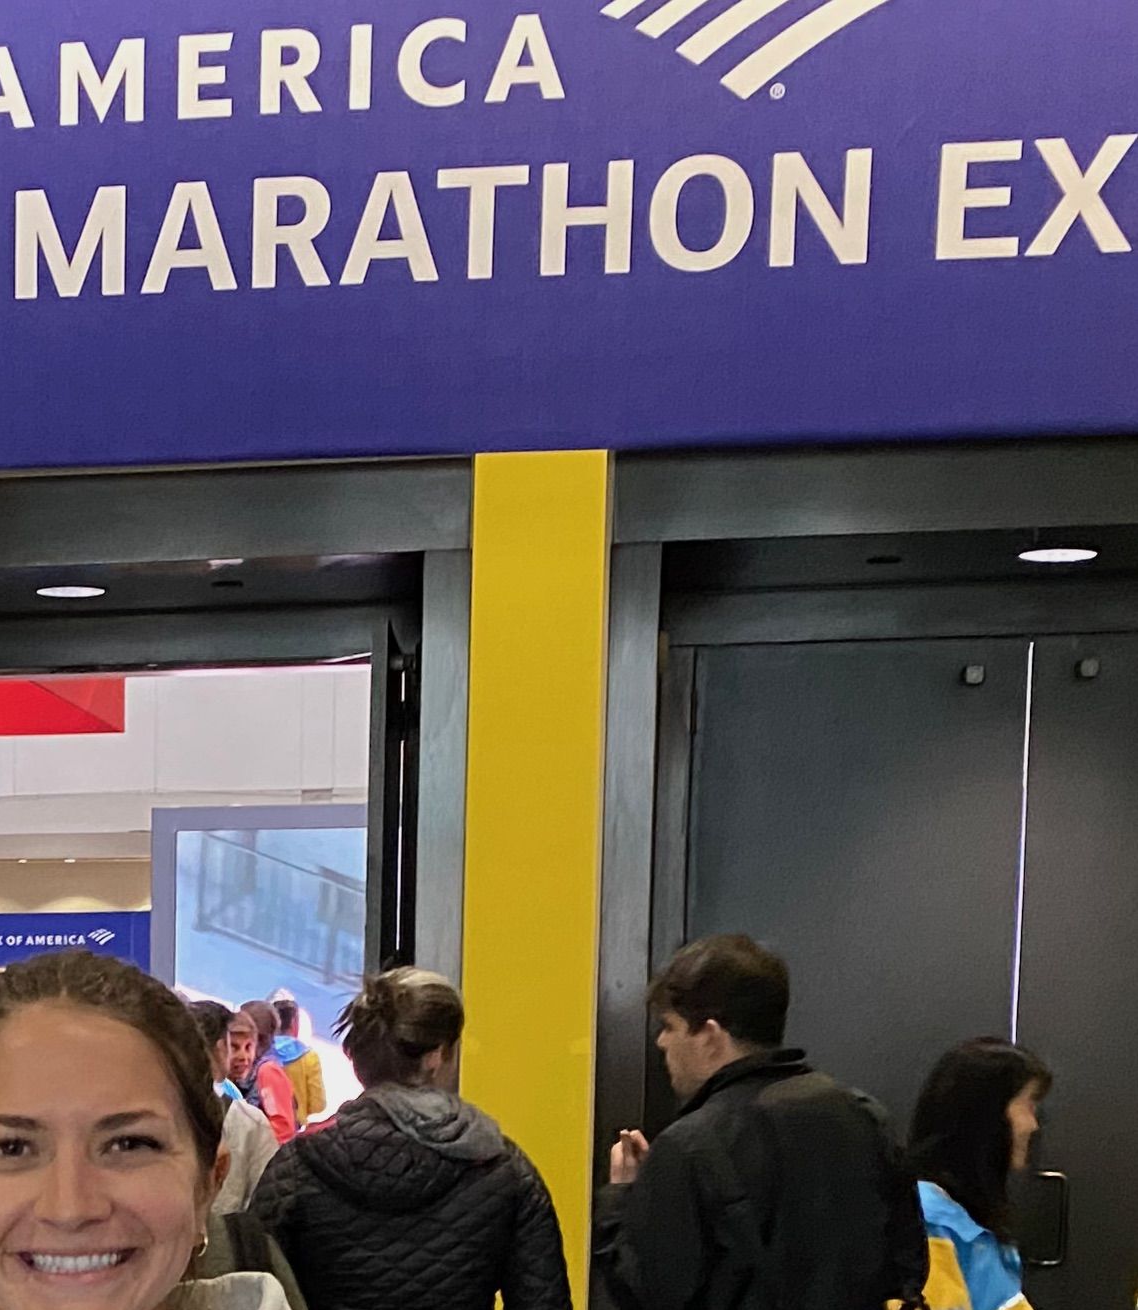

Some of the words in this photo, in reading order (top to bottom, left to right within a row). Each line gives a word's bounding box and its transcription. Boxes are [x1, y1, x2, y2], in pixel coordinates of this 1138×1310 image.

[14, 148, 873, 300] MARATHON
[935, 133, 1138, 260] EX
[6, 935, 23, 946] OF
[25, 934, 86, 946] AMERICA
